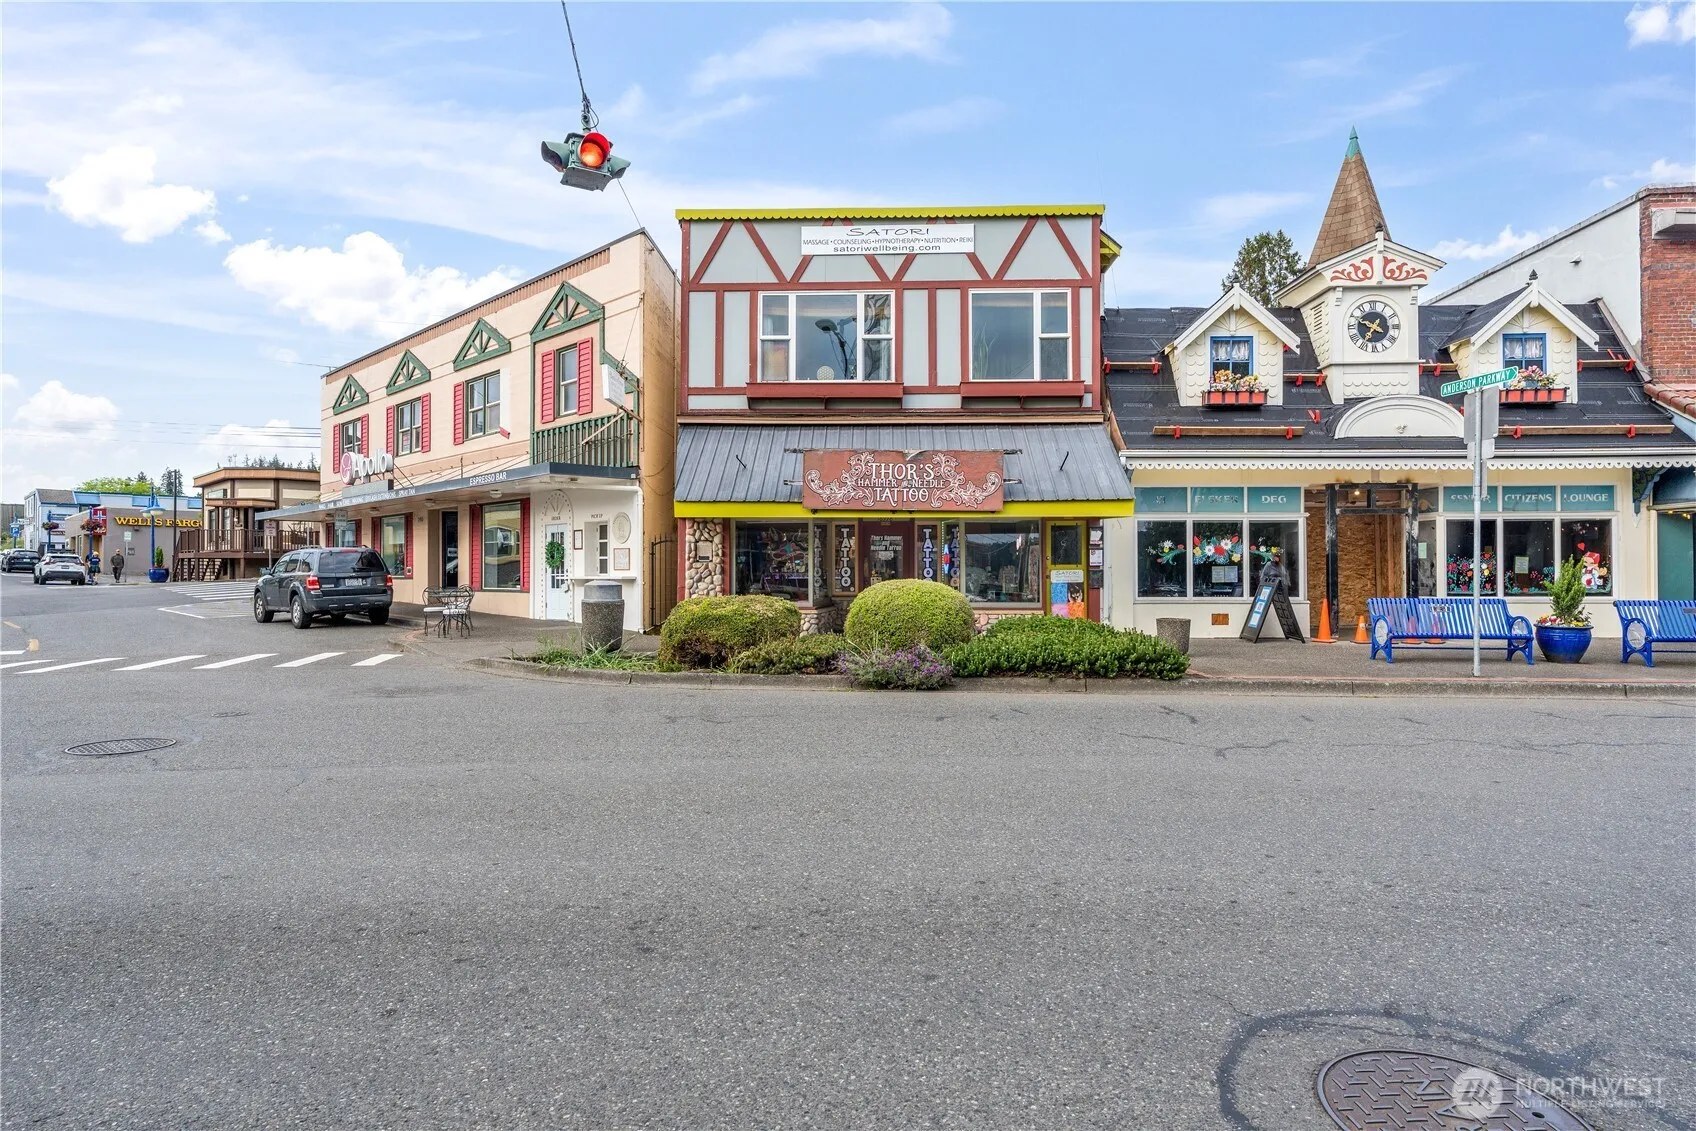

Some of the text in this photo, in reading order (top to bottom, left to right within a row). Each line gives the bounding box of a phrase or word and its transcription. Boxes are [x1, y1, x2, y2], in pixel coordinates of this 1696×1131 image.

[846, 228, 930, 237] SATORI
[833, 244, 942, 253] satoriwellbeing.com
[1442, 370, 1511, 395] ANDERSON PARKWAY
[352, 448, 393, 483] Apollo
[868, 463, 935, 480] THOR'S
[469, 471, 507, 486] ESPRESSO BAR
[857, 478, 898, 487] HAMMER
[912, 479, 946, 488] NEEDLE
[873, 487, 929, 507] TATTOO
[1504, 493, 1553, 503] CITIZENS
[165, 518, 204, 528] FARG
[841, 528, 851, 587] TATTOO
